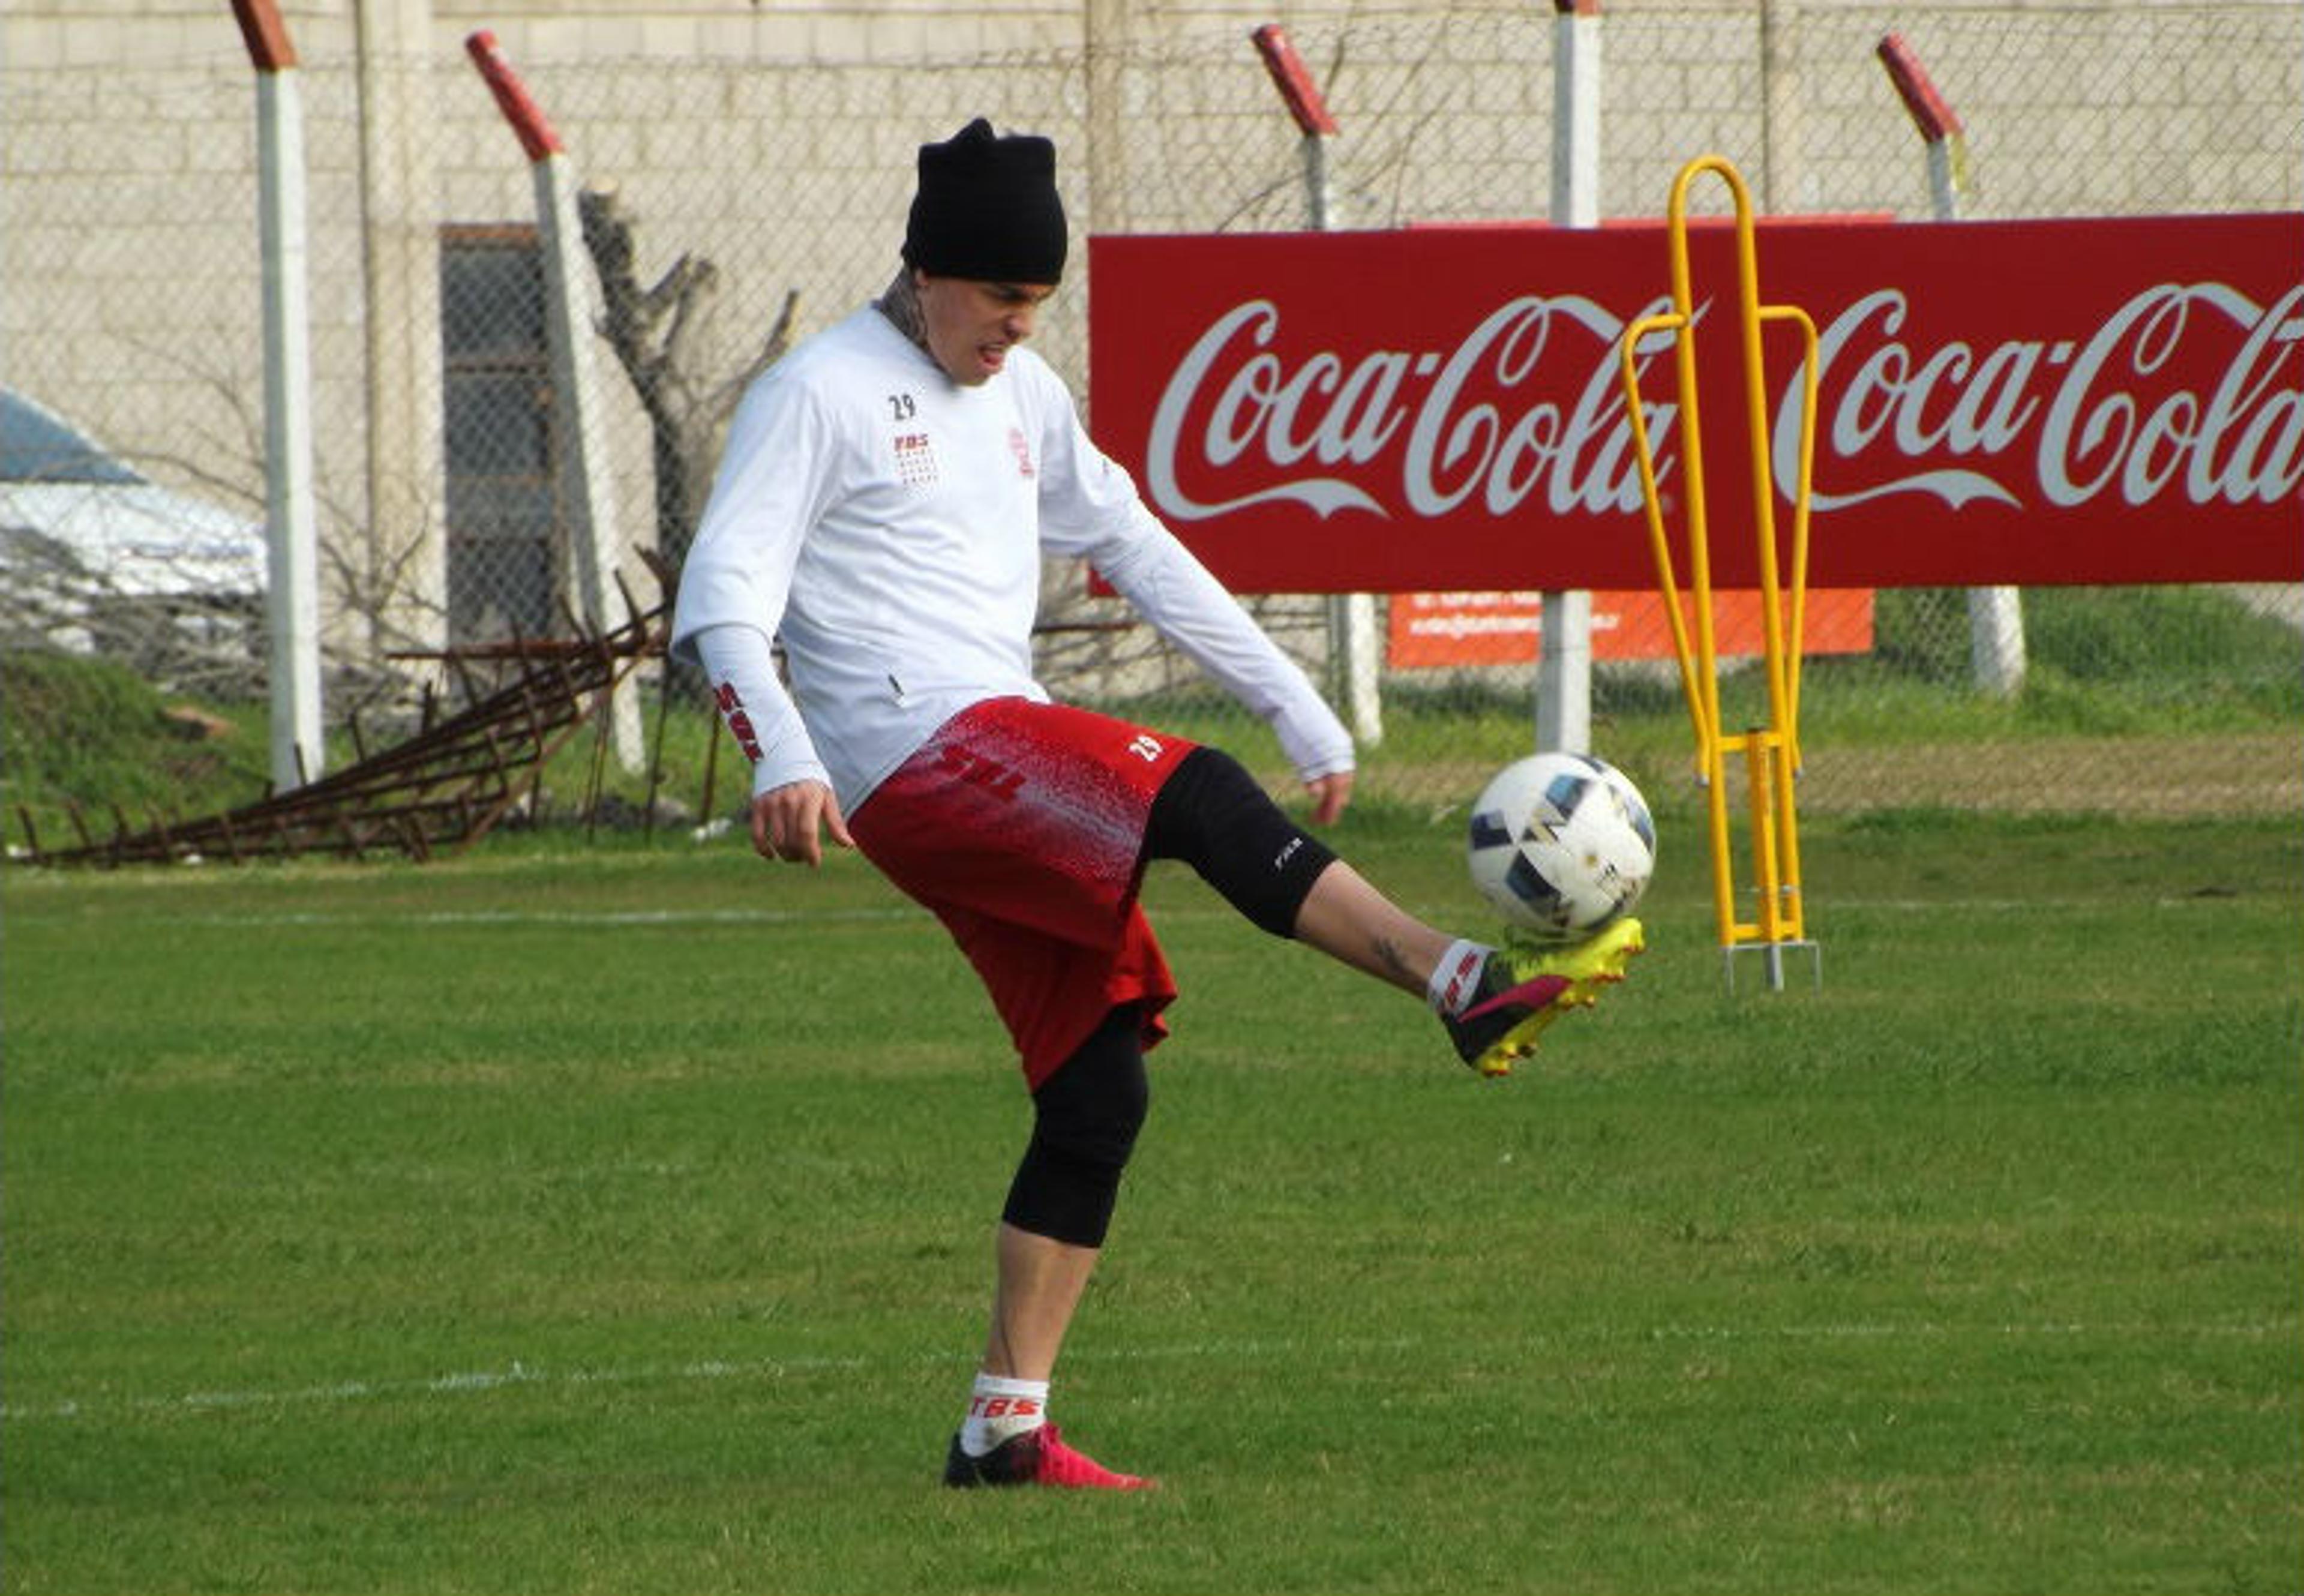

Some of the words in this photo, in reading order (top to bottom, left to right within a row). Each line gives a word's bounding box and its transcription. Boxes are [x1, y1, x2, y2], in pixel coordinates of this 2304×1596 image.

[888, 394, 916, 420] 29
[1147, 296, 1713, 521] Coca-Cola
[1772, 282, 2304, 512] Coca-Cola
[1129, 735, 1163, 762] 29
